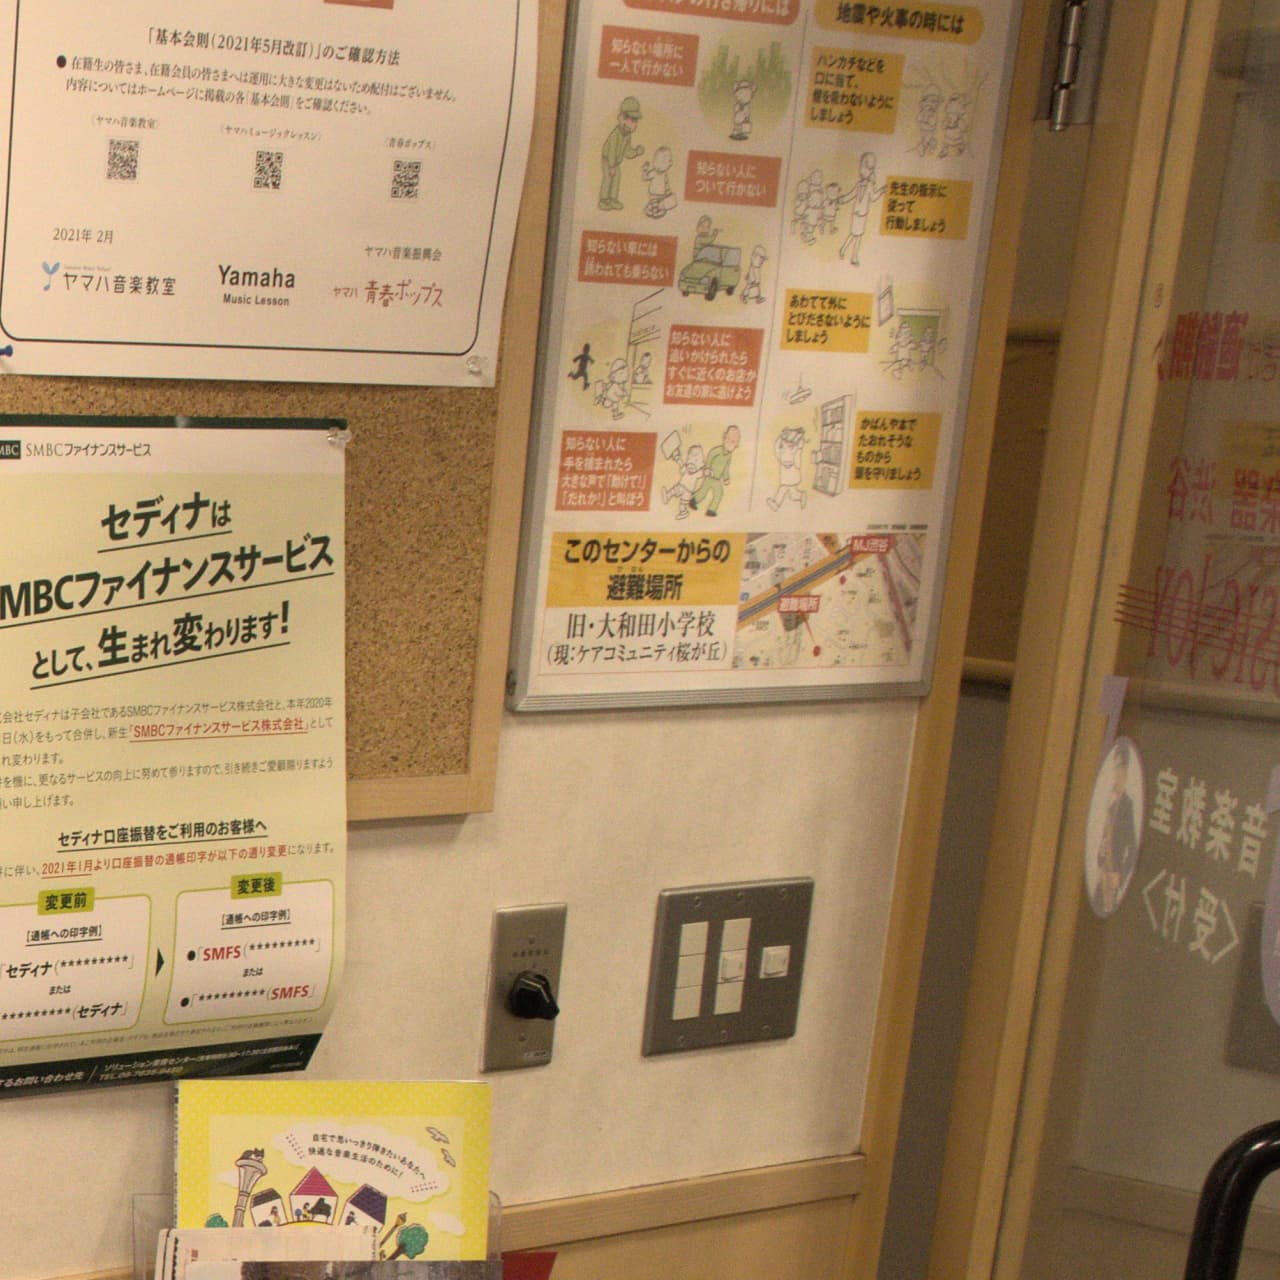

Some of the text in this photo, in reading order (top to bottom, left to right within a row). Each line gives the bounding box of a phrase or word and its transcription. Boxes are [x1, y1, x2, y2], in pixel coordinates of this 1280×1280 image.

[53, 228, 113, 244] 2021年 2月
[63, 271, 176, 296] ヤマハ音楽教室
[218, 264, 295, 289] Yamaha
[223, 293, 290, 306] Music Lesson
[333, 279, 443, 308] ヤマハ 青春ポップス
[26, 442, 152, 457] SMBCファイナンスサービス
[101, 492, 233, 541] セディナは
[563, 537, 731, 565] このセンターからの
[606, 573, 684, 601] 避難場所
[566, 611, 716, 638] 旧・大和田小学校
[236, 877, 276, 895] 変更後
[45, 893, 88, 910] 変更前
